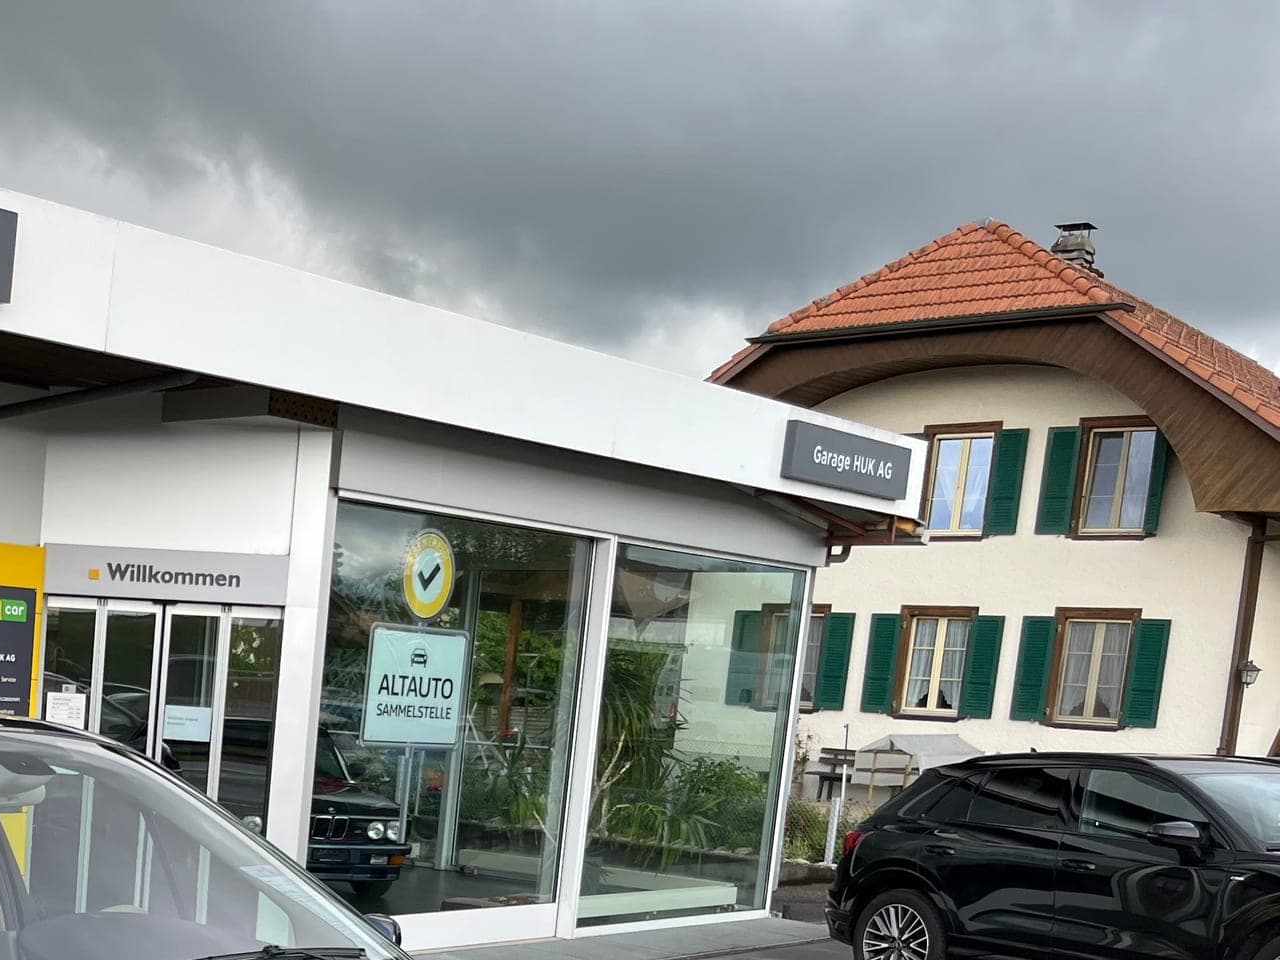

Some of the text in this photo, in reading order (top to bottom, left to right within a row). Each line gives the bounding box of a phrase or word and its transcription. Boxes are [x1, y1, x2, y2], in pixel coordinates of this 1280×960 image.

[813, 445, 893, 480] Garage HUK AG
[107, 562, 241, 588] Willkommen
[5, 605, 25, 616] car
[5, 654, 16, 662] AG
[378, 674, 454, 699] ALTAUTO
[376, 703, 452, 719] SAMMELSTELLE
